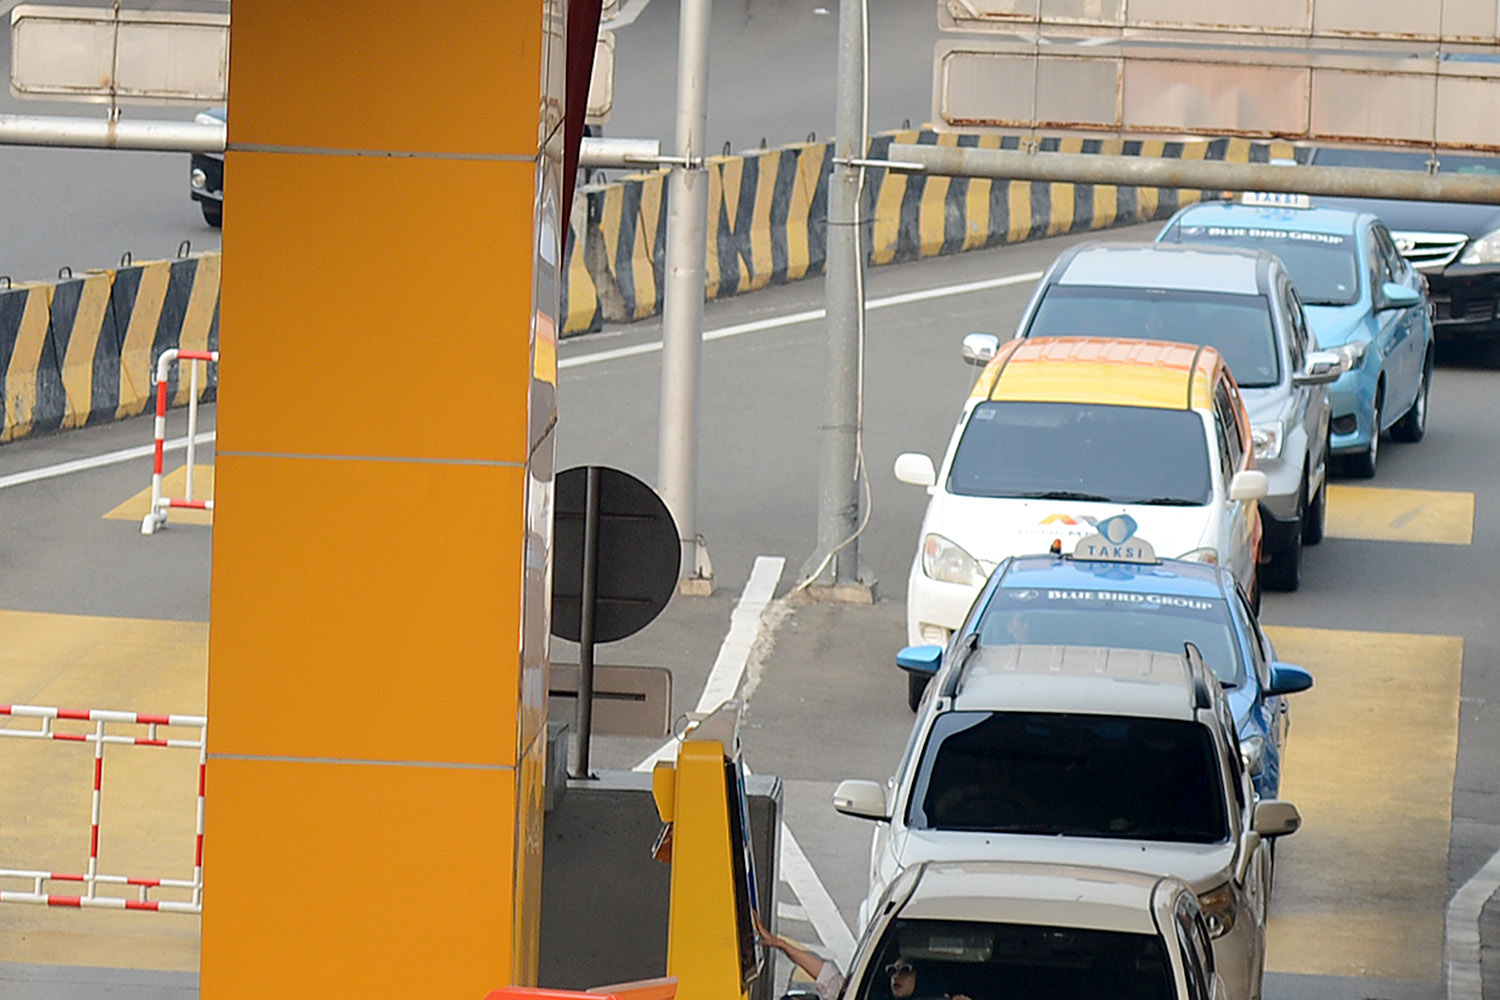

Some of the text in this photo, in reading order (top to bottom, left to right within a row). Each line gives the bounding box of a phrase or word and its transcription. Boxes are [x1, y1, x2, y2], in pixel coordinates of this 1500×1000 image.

[1254, 191, 1299, 204] TAKSI
[1208, 227, 1343, 244] BLUE BIRD GROUP
[1088, 545, 1143, 559] TAKSI
[1048, 590, 1213, 611] BLUE BIRD GROUP
